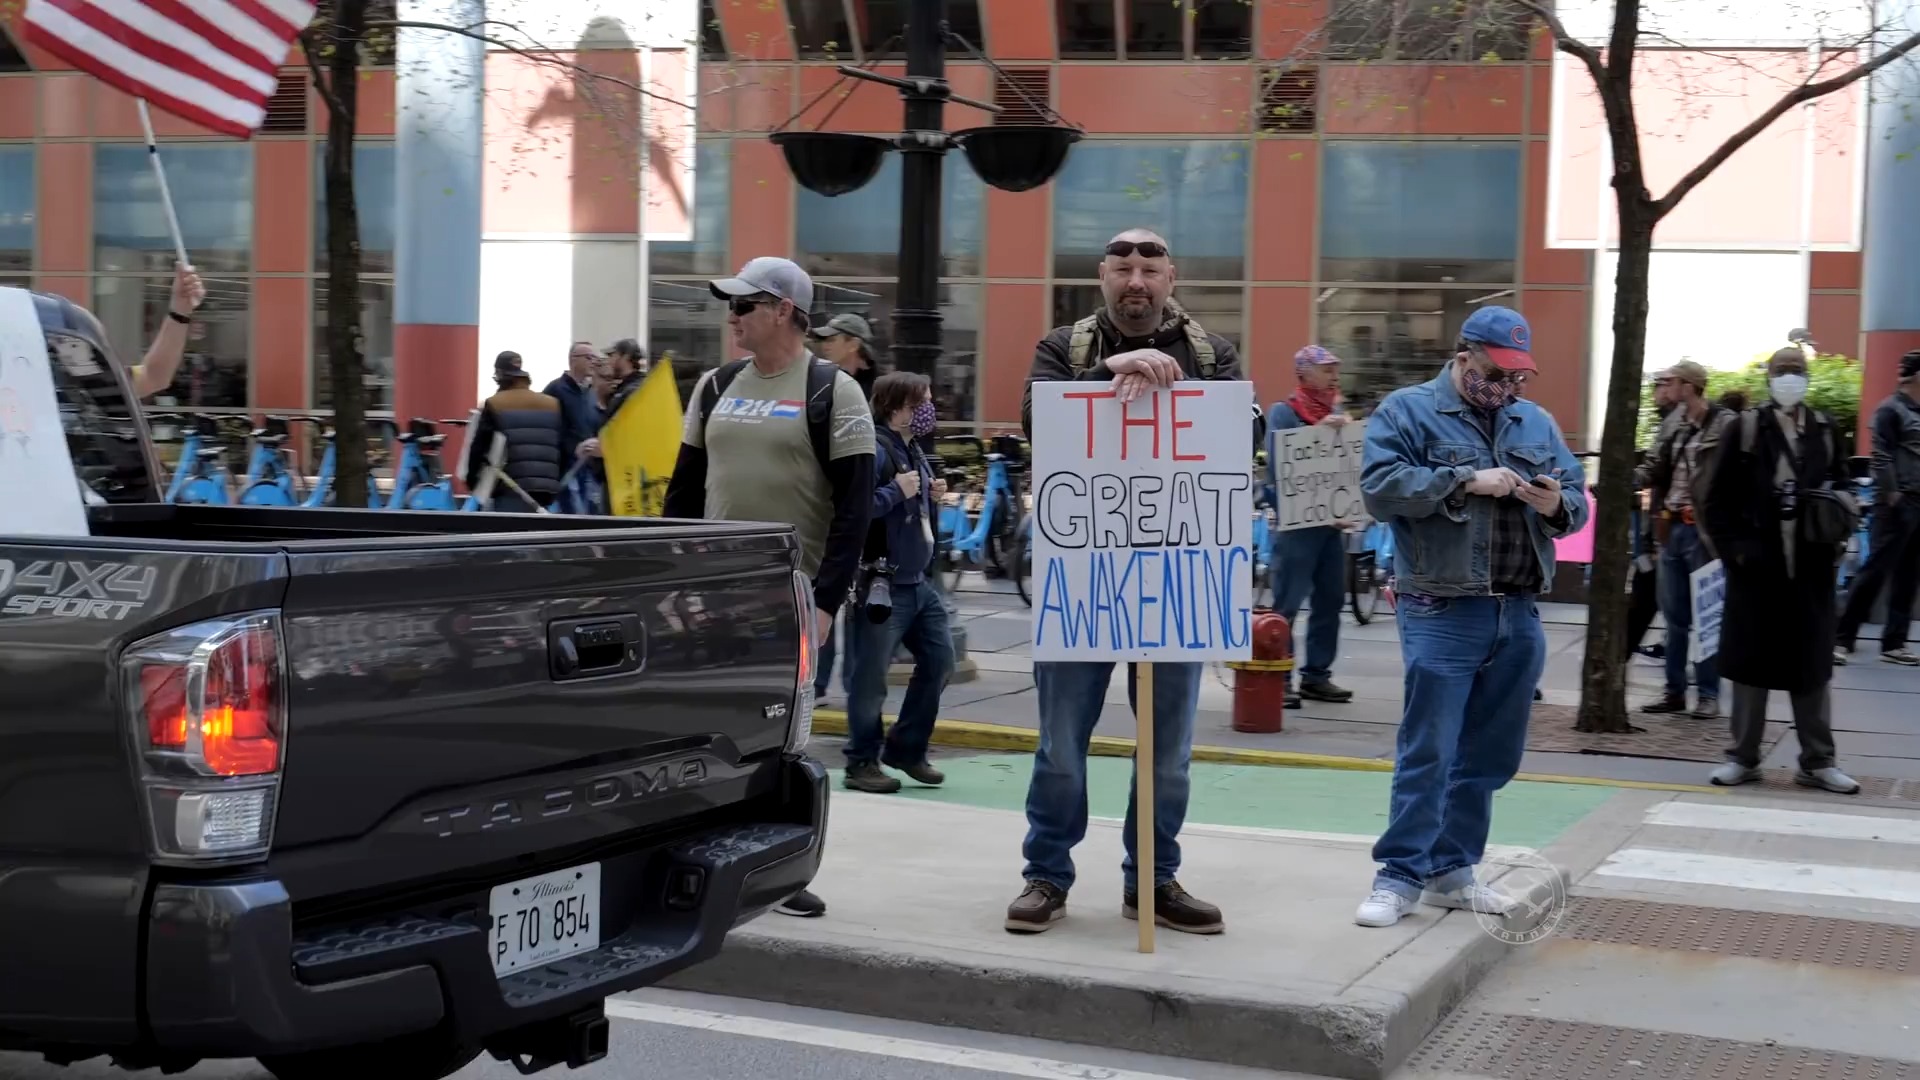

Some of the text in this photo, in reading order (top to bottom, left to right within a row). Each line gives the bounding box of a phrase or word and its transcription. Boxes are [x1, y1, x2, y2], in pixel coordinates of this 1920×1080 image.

[1063, 390, 1206, 460] THE
[1036, 471, 1249, 548] GREAT
[1, 595, 145, 620] SPORT
[1036, 546, 1250, 650] AWAKENING
[764, 703, 786, 718] V6
[421, 758, 707, 837] TACOMA
[516, 894, 589, 952] 70 854
[525, 881, 576, 902] Illinois
